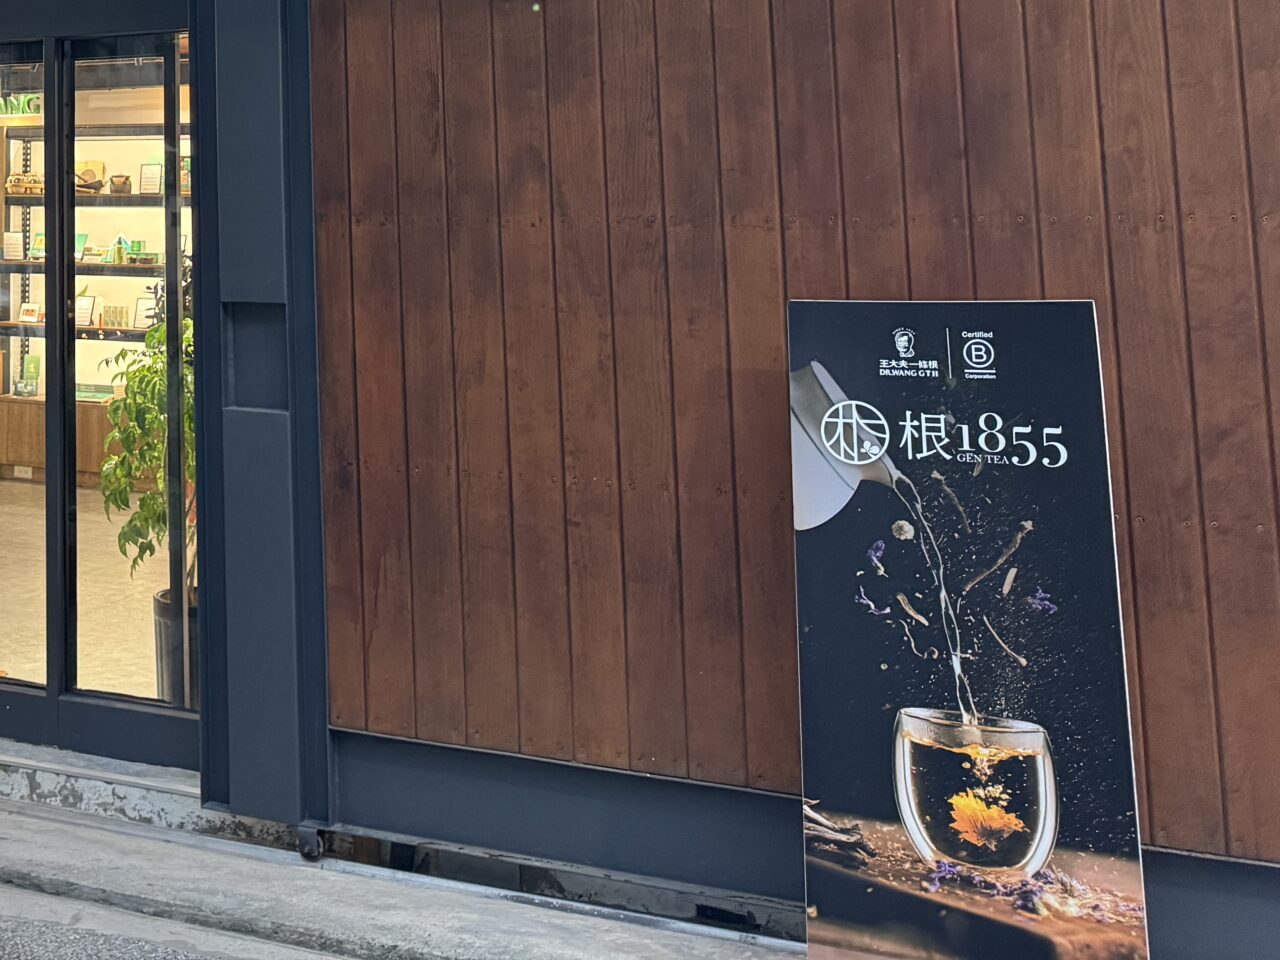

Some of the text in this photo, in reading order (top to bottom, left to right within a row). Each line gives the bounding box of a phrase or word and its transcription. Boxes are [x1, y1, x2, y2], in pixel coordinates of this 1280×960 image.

[961, 331, 994, 339] Certified
[970, 344, 988, 363] B
[956, 452, 1010, 465] GEN TEA
